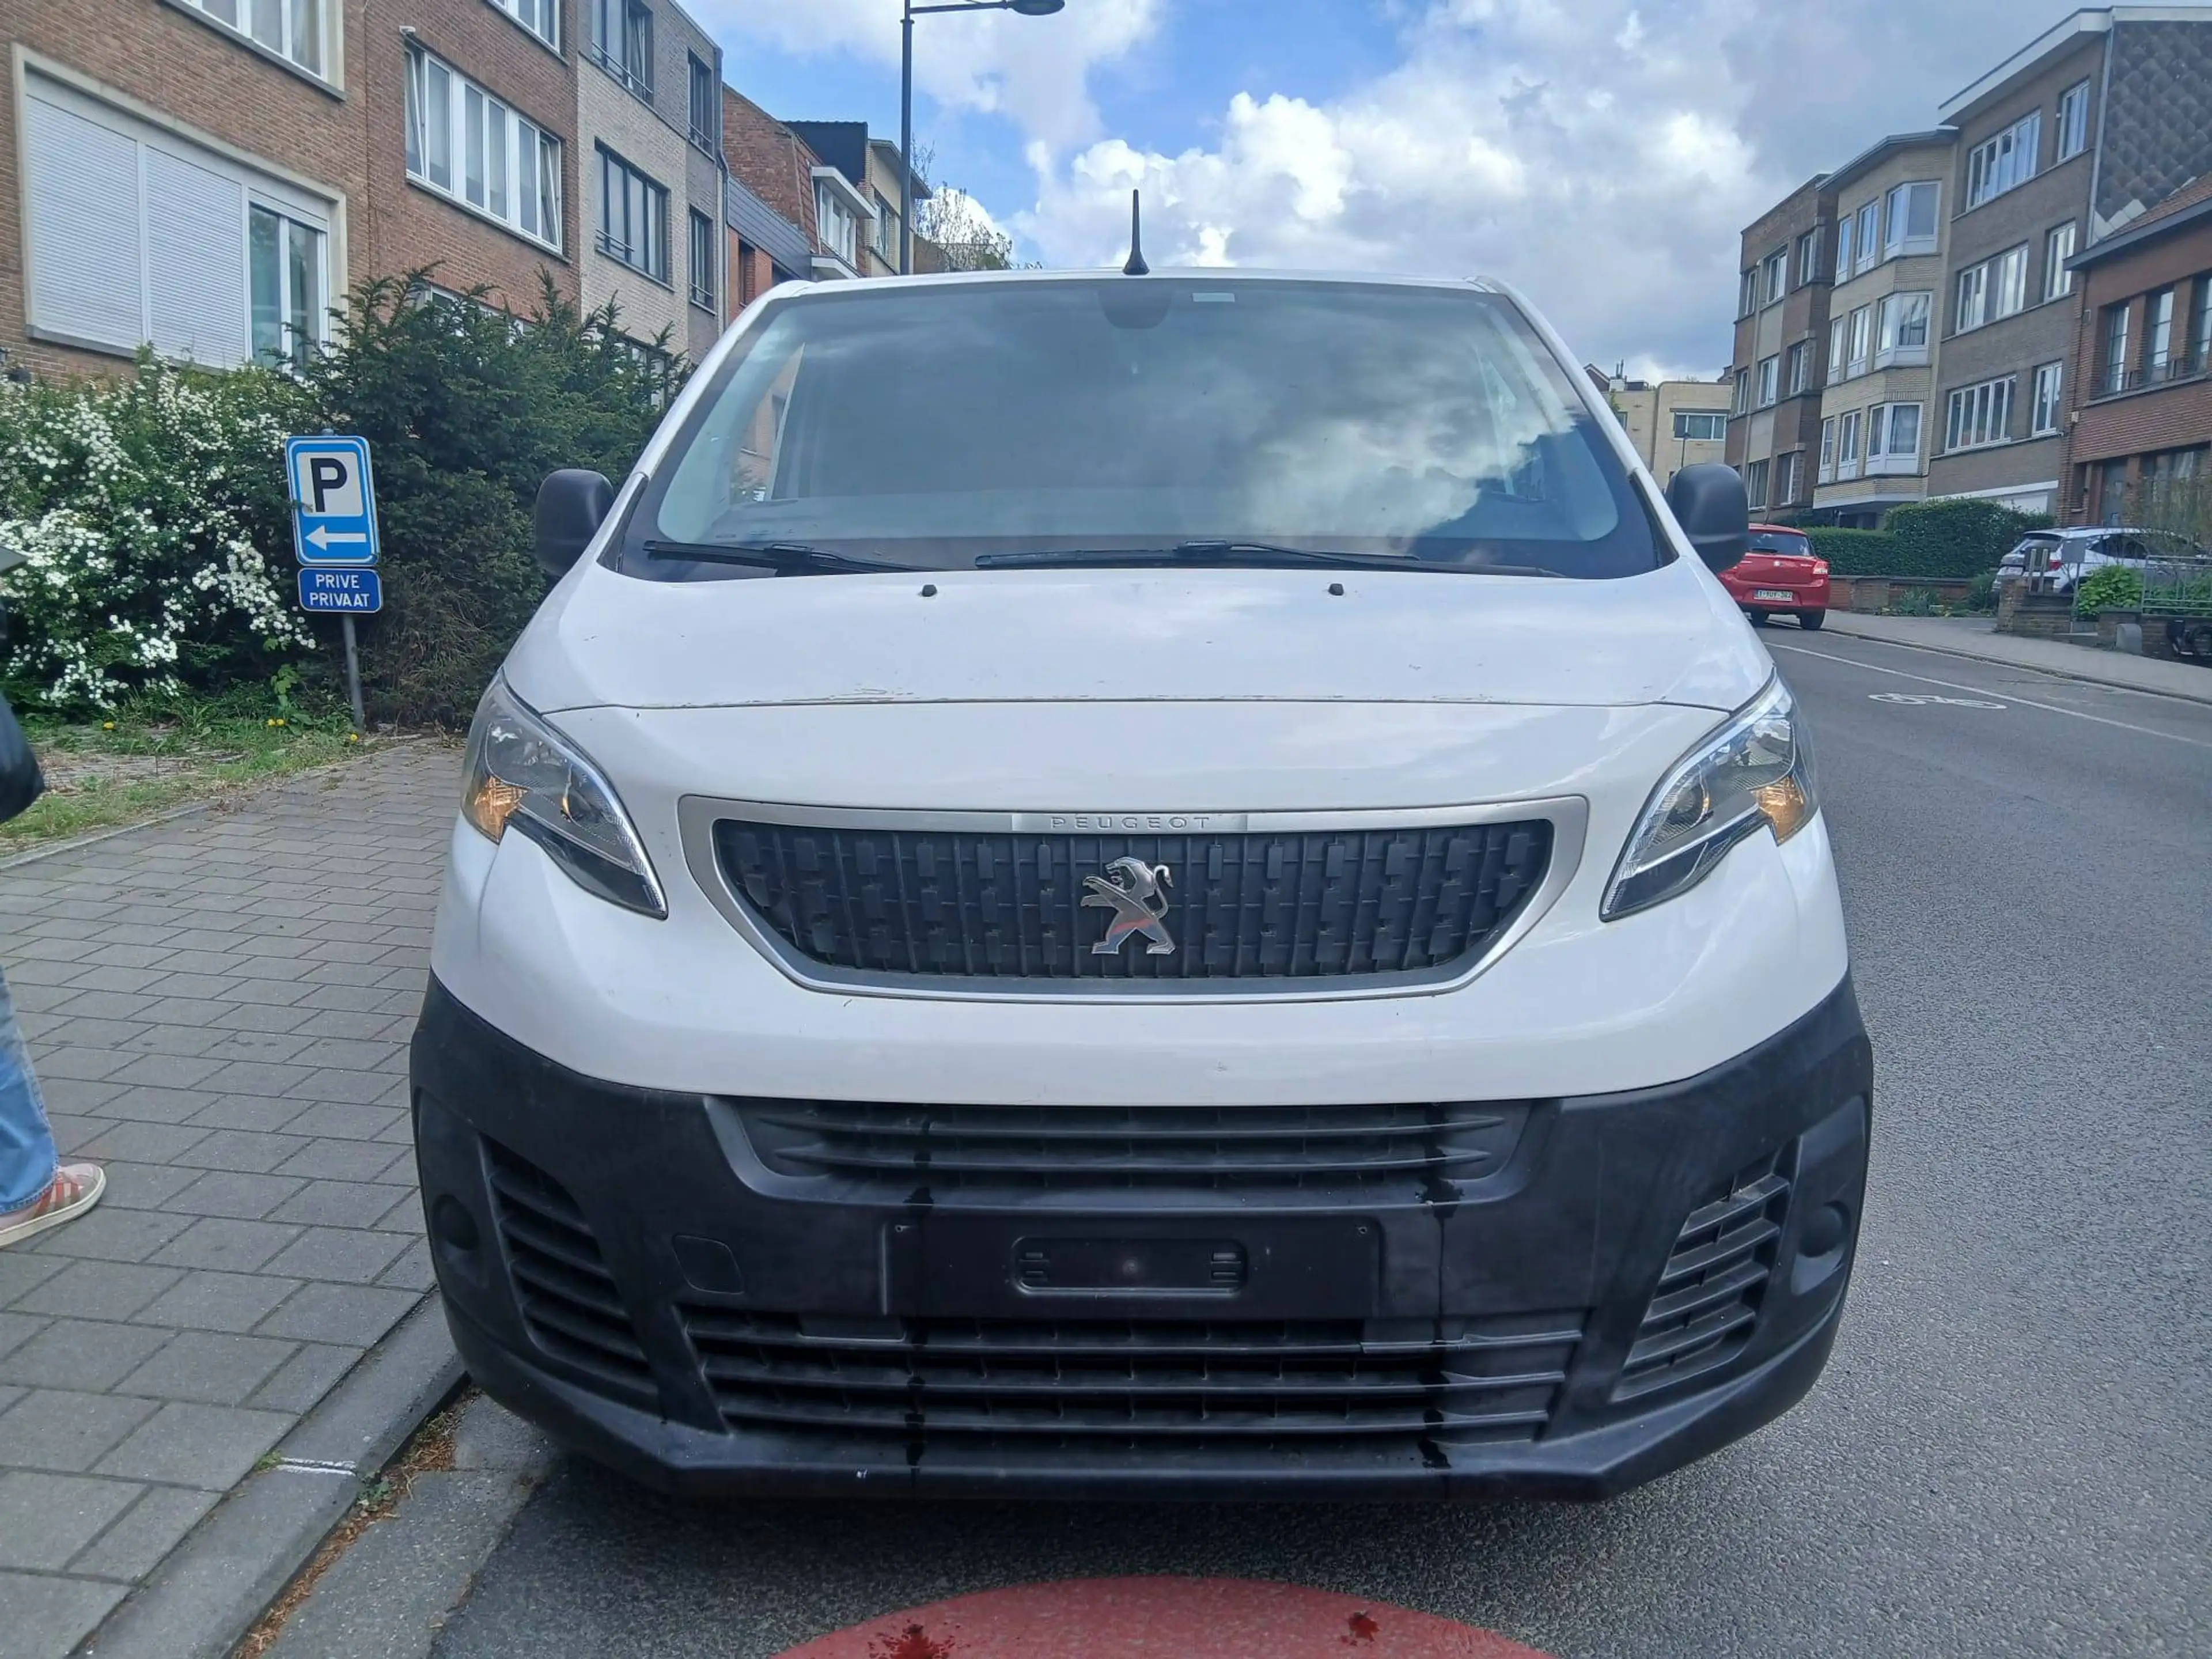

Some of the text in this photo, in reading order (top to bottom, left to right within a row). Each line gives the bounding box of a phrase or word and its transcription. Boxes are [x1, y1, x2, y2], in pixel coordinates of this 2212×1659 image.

[310, 457, 347, 513] P
[316, 574, 360, 589] PRIVE
[309, 592, 370, 608] PRIVAAT
[1050, 816, 1210, 830] PEUGEOT
